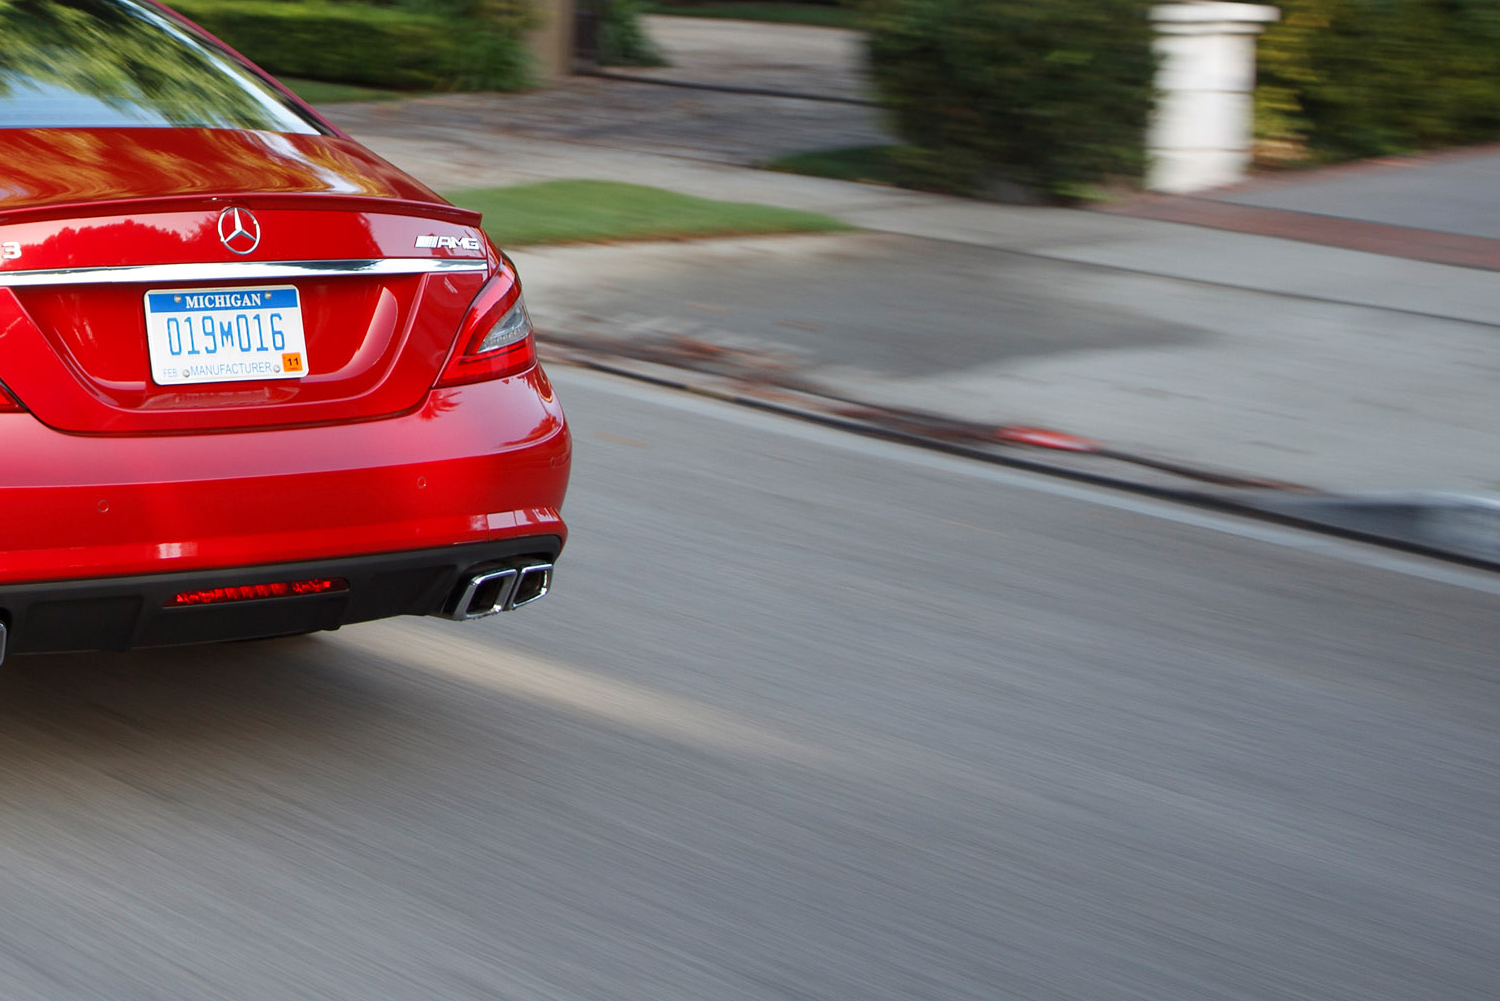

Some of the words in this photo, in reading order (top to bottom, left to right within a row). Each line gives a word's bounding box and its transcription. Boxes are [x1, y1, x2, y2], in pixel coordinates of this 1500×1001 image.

[437, 236, 480, 250] AMG
[185, 293, 261, 309] MICHIGAN
[166, 313, 285, 356] 019M016
[190, 361, 272, 376] MANUFACTURER
[287, 357, 300, 367] 11
